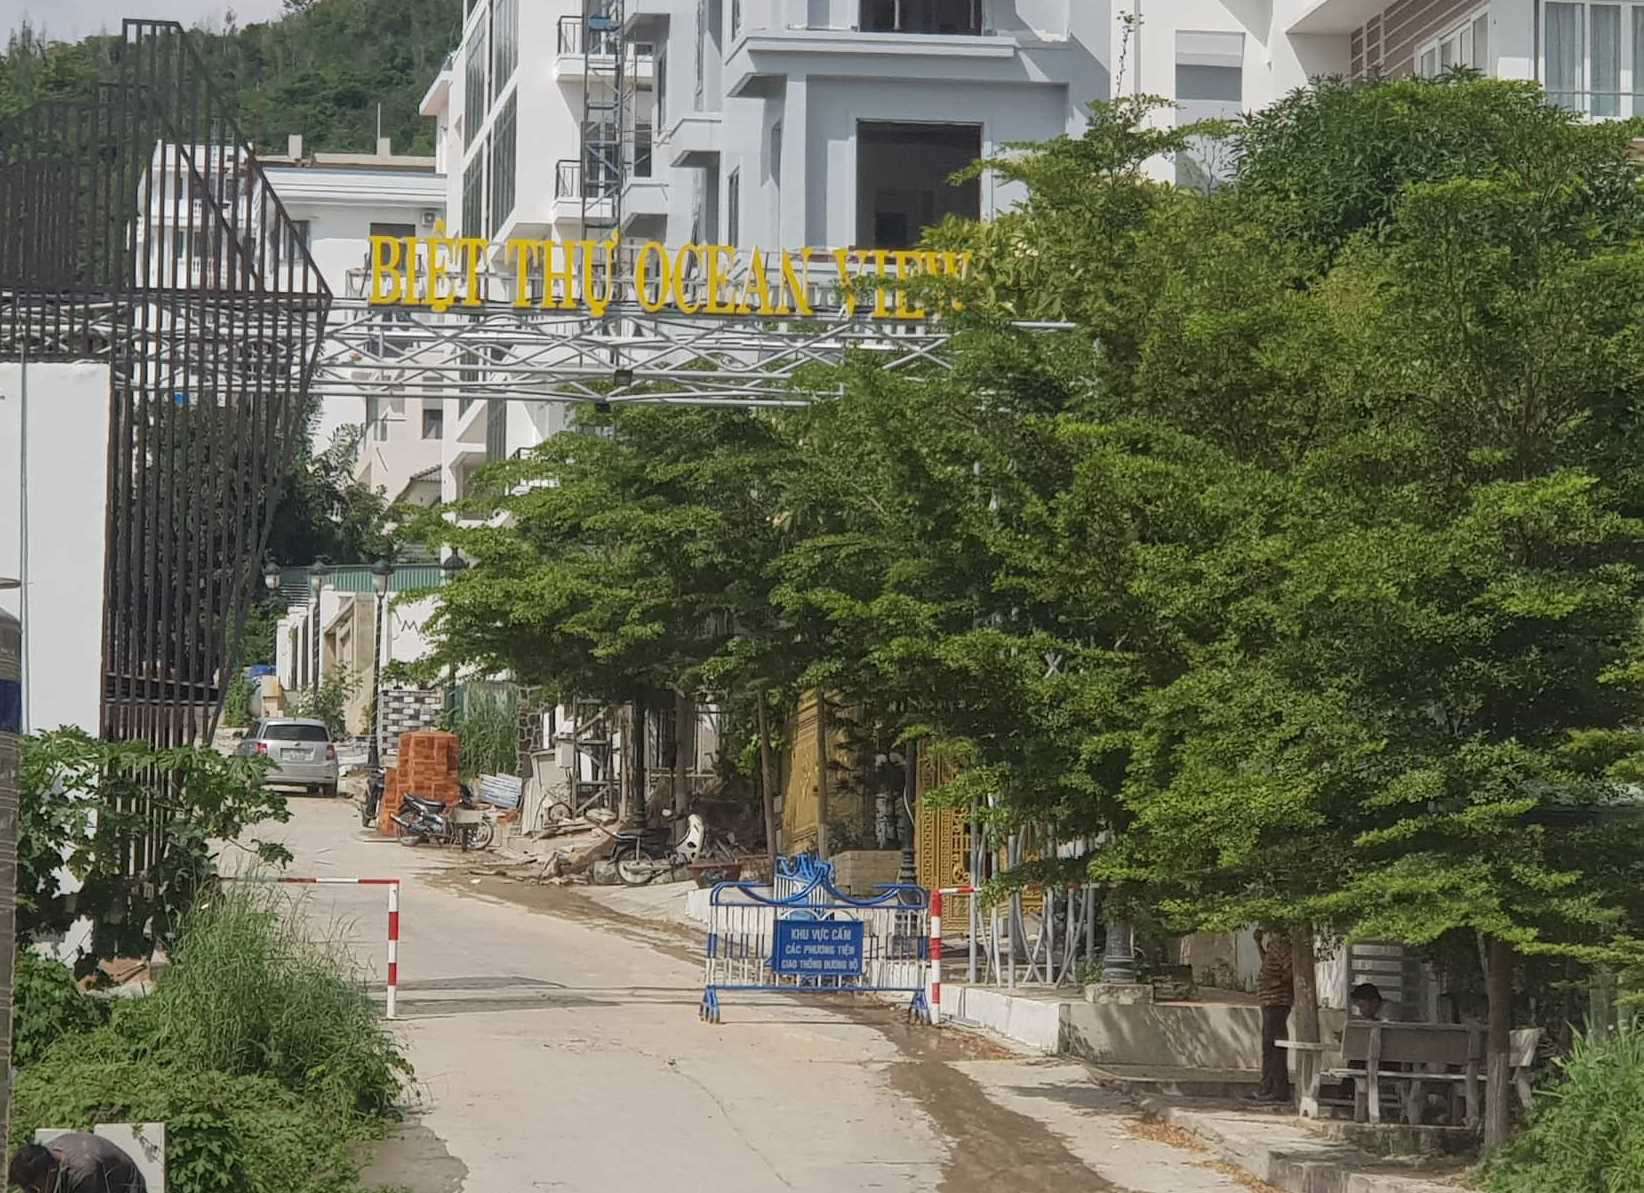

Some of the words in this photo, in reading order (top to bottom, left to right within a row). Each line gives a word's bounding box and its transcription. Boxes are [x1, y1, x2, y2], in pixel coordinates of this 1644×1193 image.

[368, 218, 488, 313] BIỆT
[504, 228, 620, 318] THỰ
[634, 240, 815, 316] OCEAN
[791, 928, 809, 940] KHU
[811, 927, 829, 943] VỰC
[832, 926, 851, 941] CẤM
[785, 942, 801, 954] CÁC
[781, 959, 797, 969] GIAO
